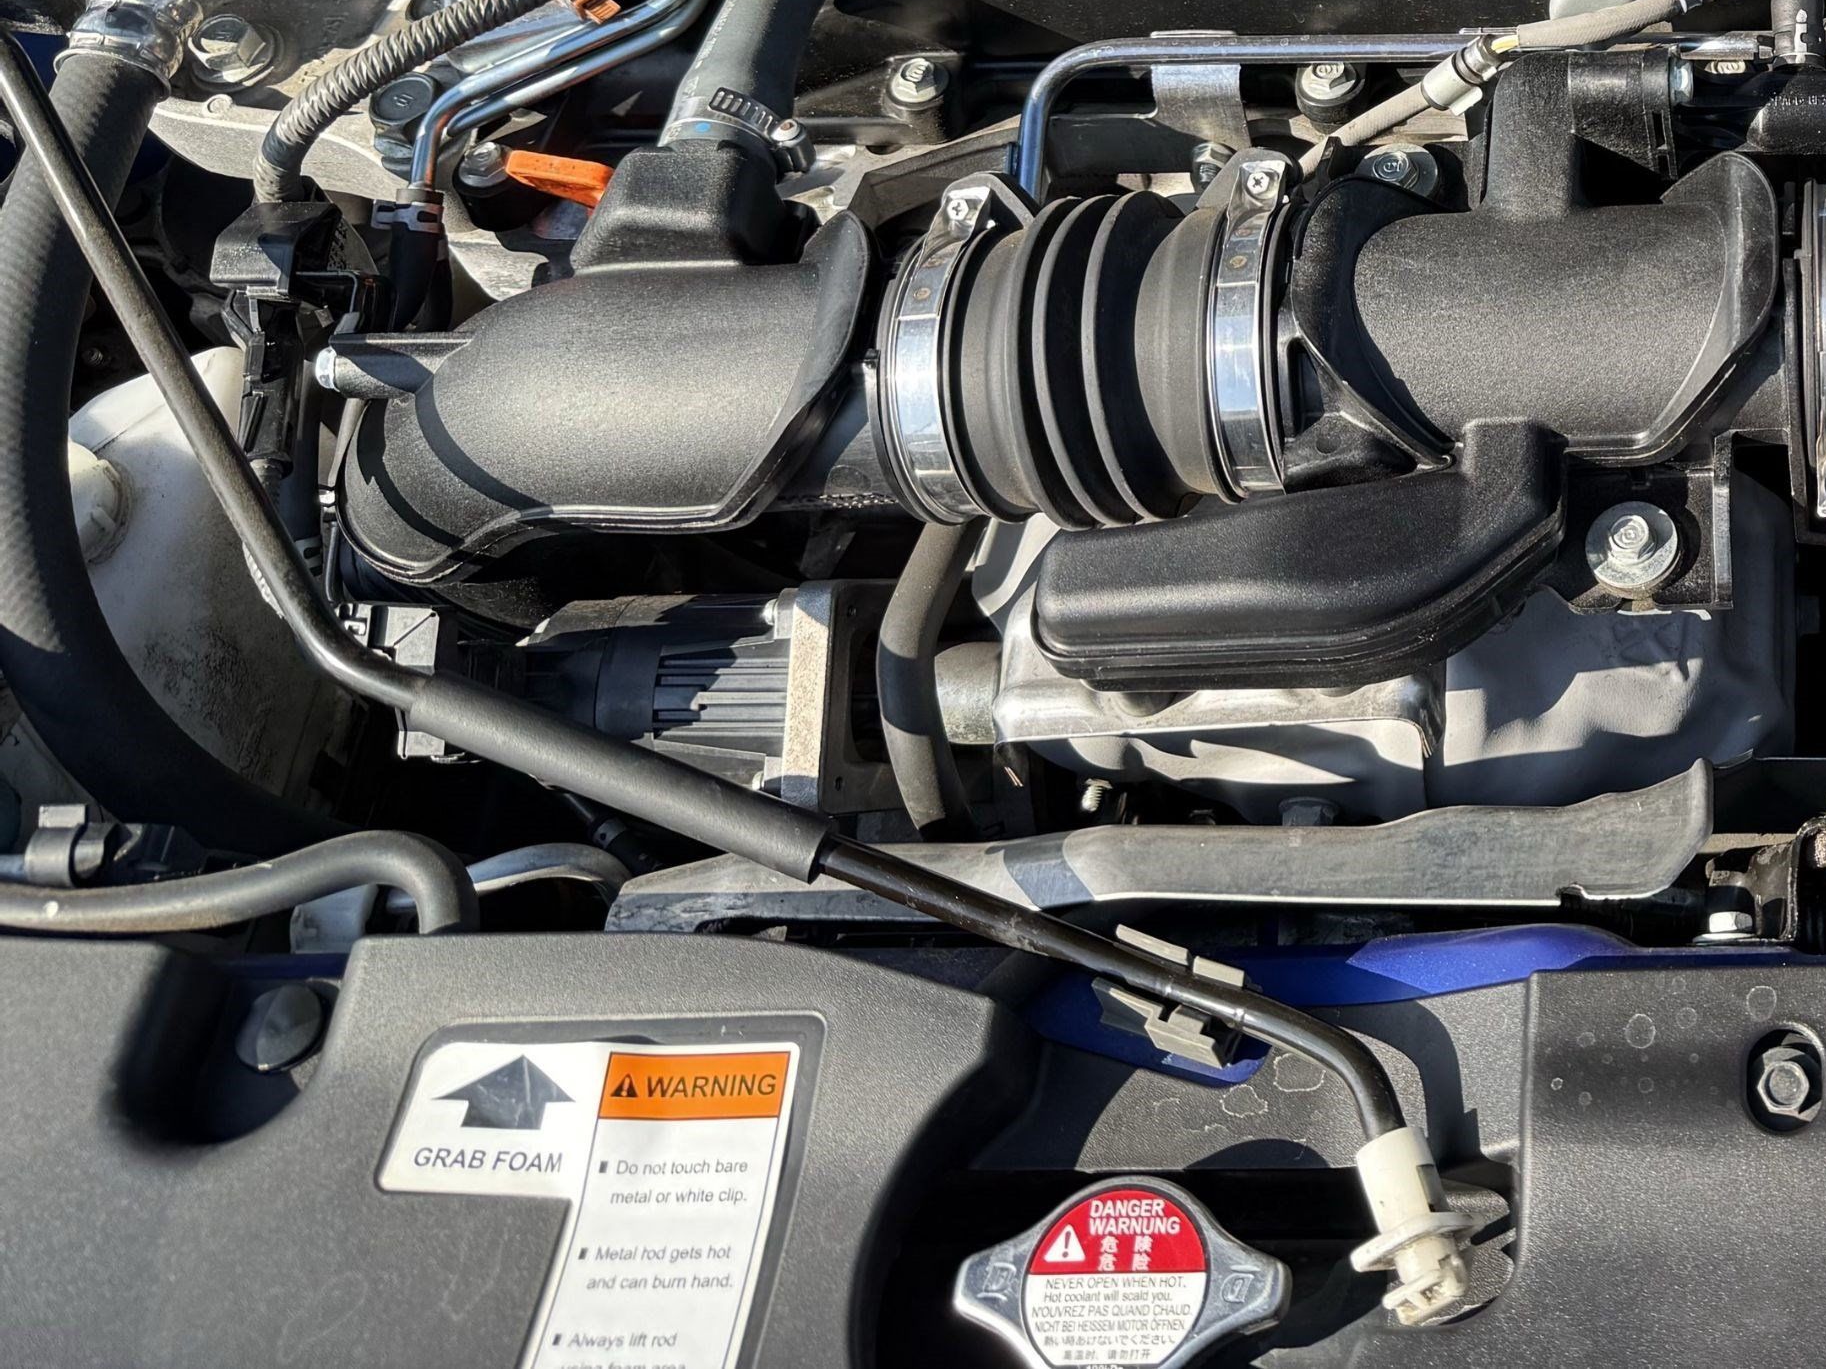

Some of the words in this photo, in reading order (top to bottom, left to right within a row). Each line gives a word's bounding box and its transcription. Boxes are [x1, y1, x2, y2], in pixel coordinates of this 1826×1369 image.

[646, 1074, 777, 1099] WARNING
[414, 1147, 487, 1169] GRAB
[492, 1150, 563, 1174] FOAM
[616, 1160, 638, 1175] Do
[642, 1161, 667, 1175] not
[670, 1159, 710, 1175] touch
[715, 1159, 748, 1173] bare
[610, 1189, 652, 1204] metal
[655, 1191, 671, 1204] or
[675, 1187, 714, 1203] white
[718, 1187, 747, 1205] clip.
[1090, 1199, 1166, 1218] DANGER
[1090, 1216, 1181, 1235] WARNUNG
[595, 1245, 638, 1260] Metal
[641, 1245, 667, 1260] rod
[670, 1245, 702, 1263] gets
[706, 1244, 731, 1259] hot
[586, 1275, 617, 1290] and
[620, 1277, 648, 1290] can
[652, 1274, 687, 1290] burn
[691, 1273, 733, 1289] hand.
[1046, 1277, 1084, 1289] NEVER
[1087, 1276, 1118, 1288] OPEN
[1122, 1276, 1156, 1288] WHEN
[1159, 1276, 1187, 1288] HOT.
[1044, 1291, 1062, 1303] Hot
[1064, 1290, 1101, 1302] coolant
[1103, 1290, 1120, 1302] will
[1122, 1290, 1149, 1302] scald
[1088, 1304, 1110, 1316] PAS
[1112, 1304, 1150, 1316] QUAND
[1035, 1320, 1061, 1332] NICHT
[1062, 1320, 1076, 1332] BEI
[1078, 1319, 1115, 1332] HEISSEM
[1117, 1319, 1149, 1331] MOTOR
[568, 1333, 625, 1351] Always
[628, 1333, 648, 1347] lift
[651, 1333, 677, 1347] rod
